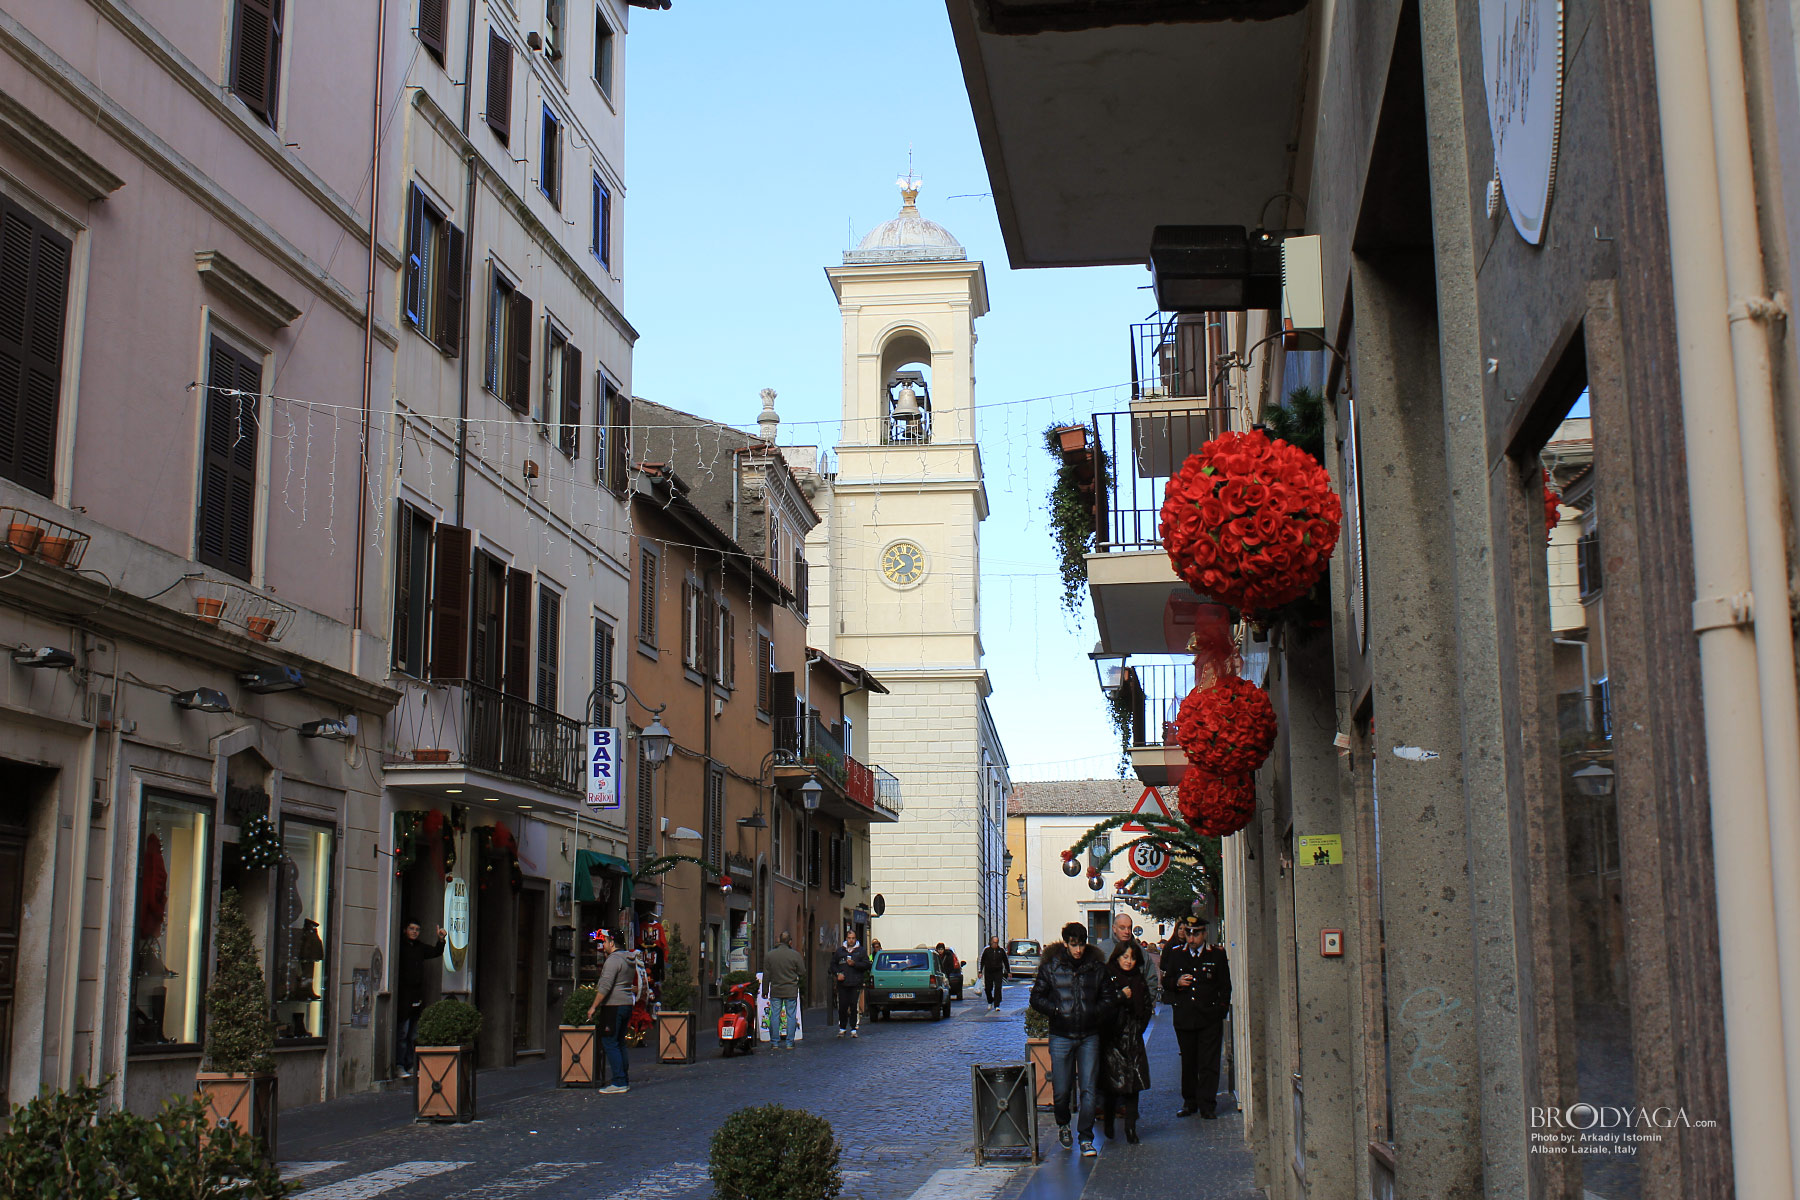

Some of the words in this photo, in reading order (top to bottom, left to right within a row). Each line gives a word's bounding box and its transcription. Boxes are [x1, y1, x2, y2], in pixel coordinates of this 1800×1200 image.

[592, 730, 612, 778] BAR
[1137, 848, 1161, 866] 30
[454, 882, 466, 897] BAR
